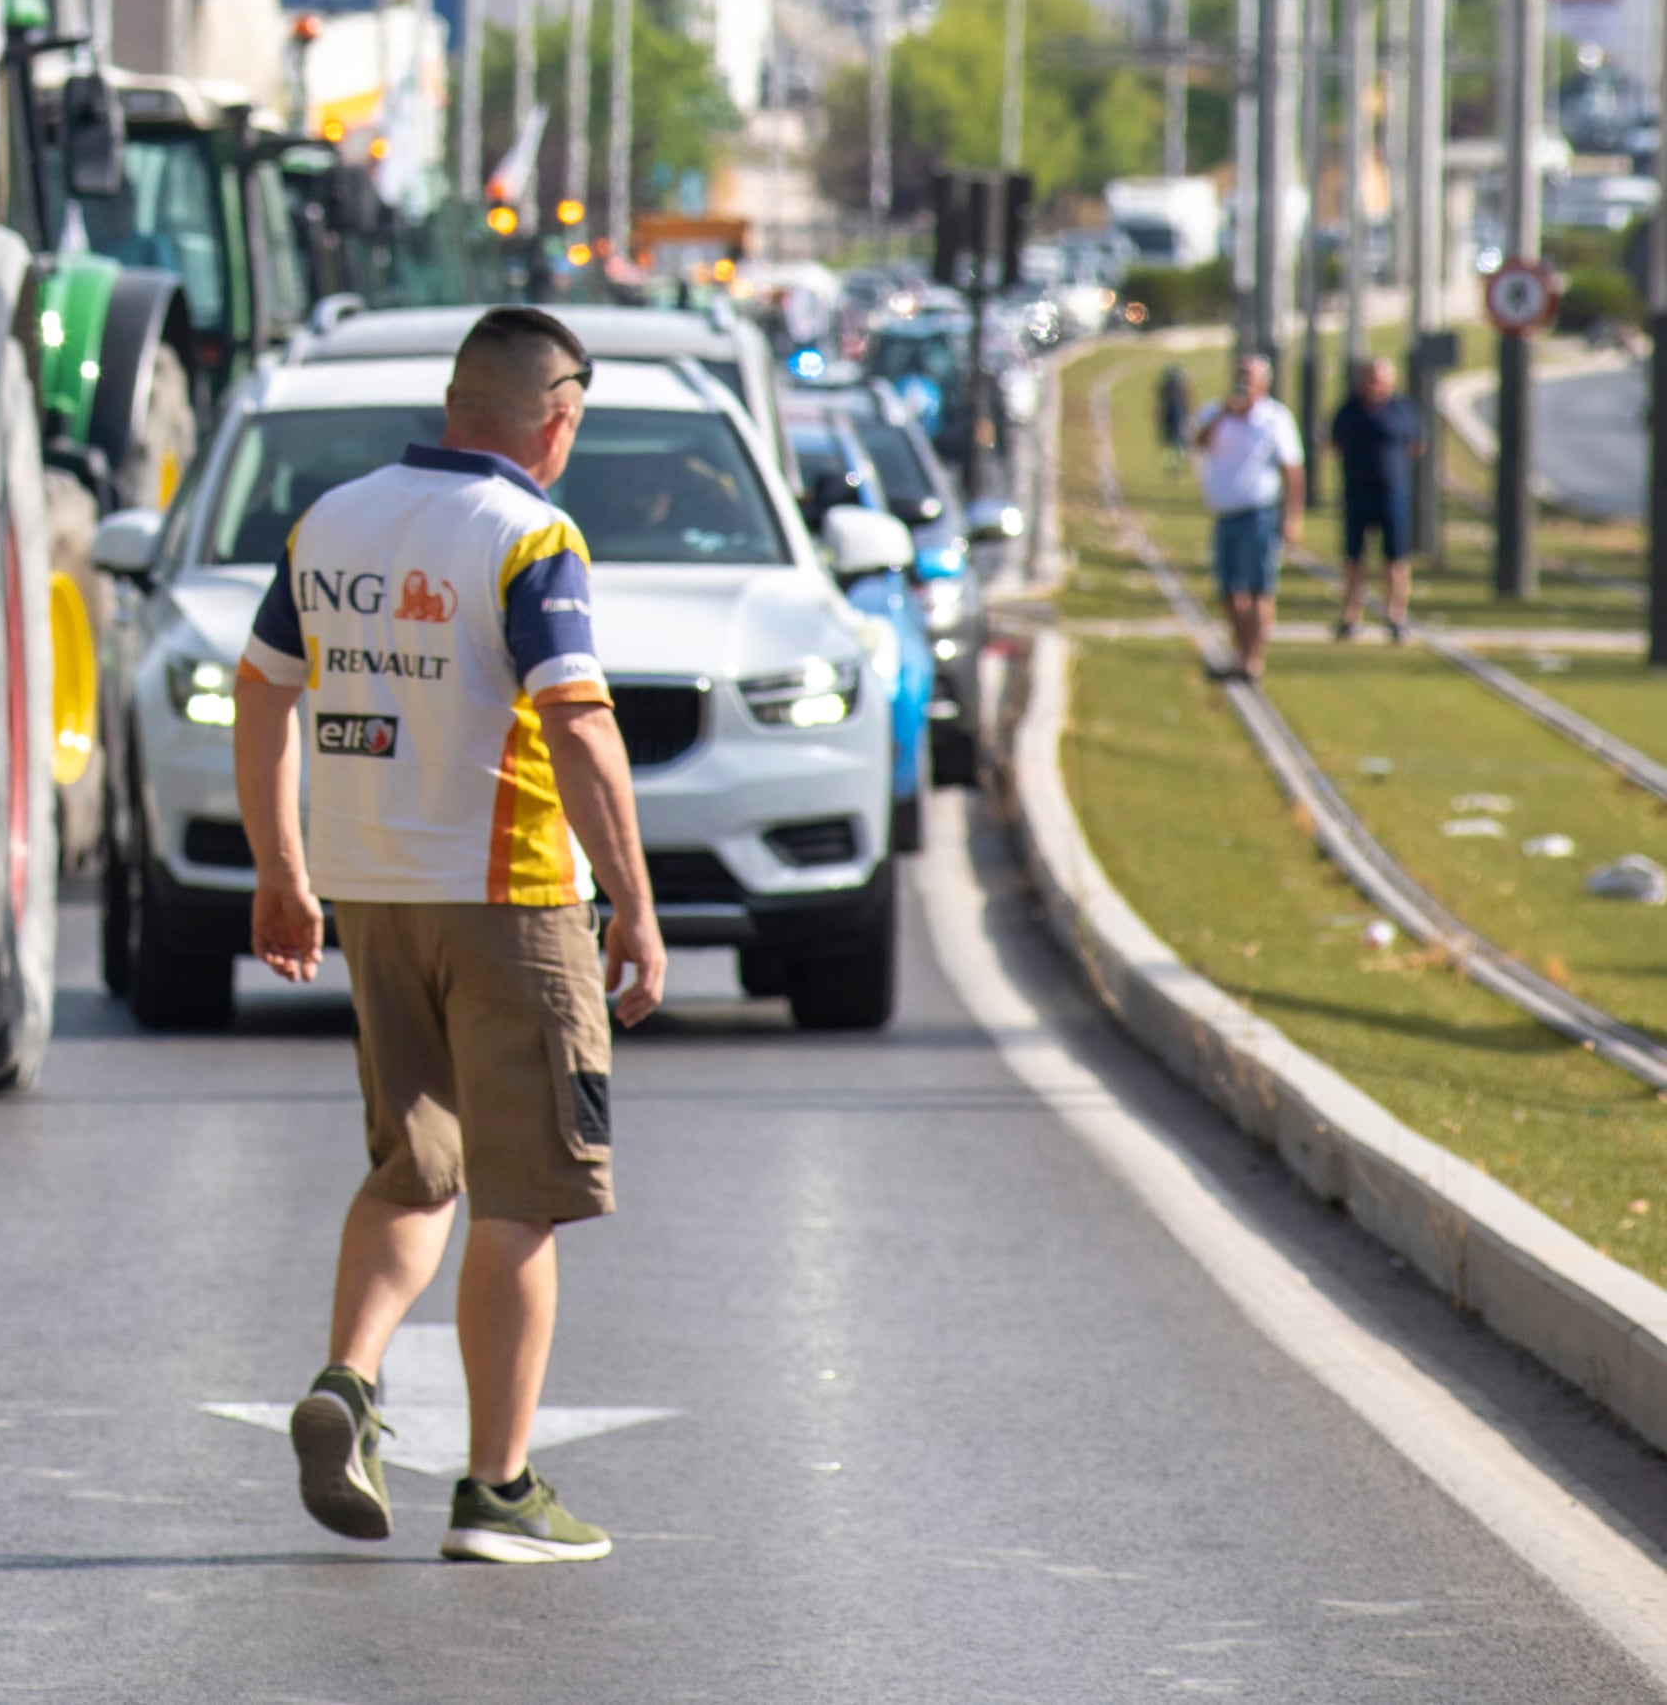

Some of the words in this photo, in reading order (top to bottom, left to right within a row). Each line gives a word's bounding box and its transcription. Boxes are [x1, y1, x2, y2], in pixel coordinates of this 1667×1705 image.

[299, 569, 386, 615] ING
[327, 647, 450, 681] RENAULT
[318, 718, 364, 749] elf
